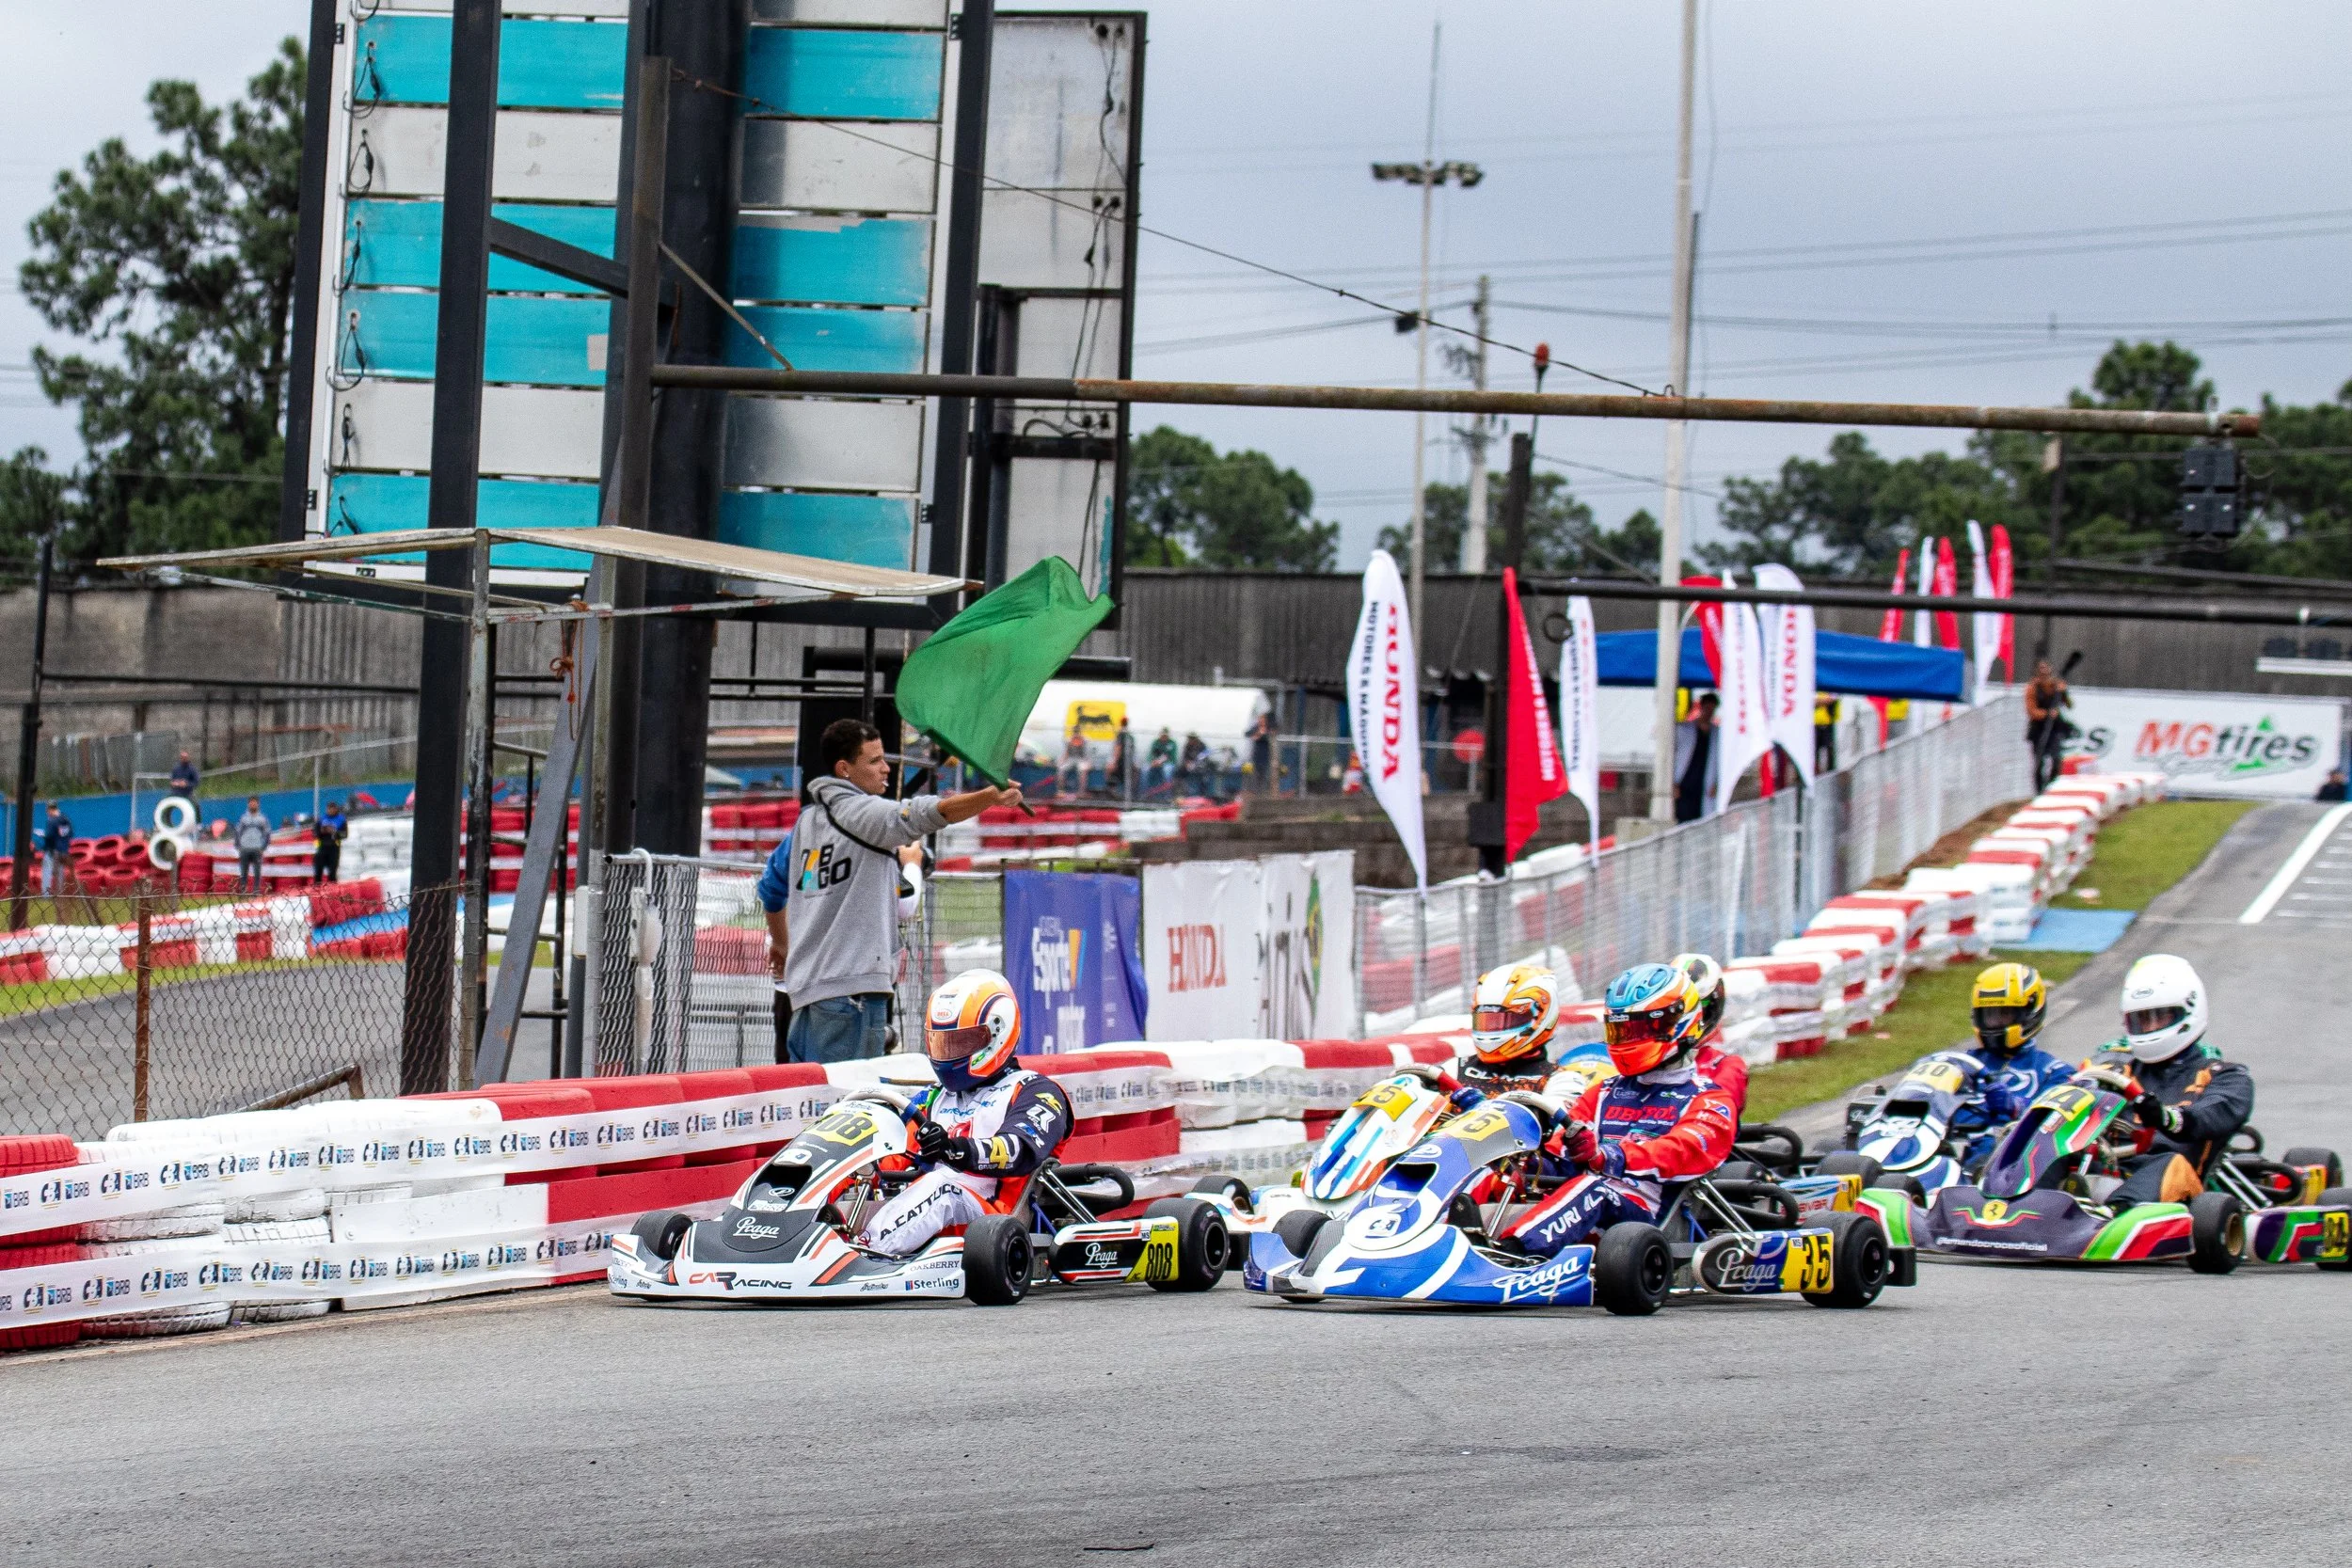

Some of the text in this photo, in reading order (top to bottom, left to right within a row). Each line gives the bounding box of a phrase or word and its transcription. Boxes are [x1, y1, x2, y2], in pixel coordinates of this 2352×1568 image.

[2134, 721, 2317, 764] MGtires
[1168, 924, 1226, 992] HNDA
[13, 1191, 29, 1207] BRB
[73, 1182, 89, 1197] BRB
[134, 1172, 150, 1188] BRB
[192, 1164, 209, 1179] BRB
[245, 1157, 260, 1172] BRB
[295, 1152, 310, 1166] BRB
[342, 1148, 355, 1163] BRB
[387, 1146, 400, 1160] BRB
[733, 1217, 780, 1240] Praga
[880, 1183, 962, 1241] A.CATTUCCI
[1539, 1207, 1582, 1243] YURI
[910, 1260, 960, 1272] OAKBERRY
[1085, 1243, 1118, 1268] Praga
[1145, 1243, 1173, 1281] 808
[1716, 1247, 1776, 1292] Praga
[1801, 1235, 1831, 1290] 35
[56, 1288, 72, 1304] BRB
[115, 1279, 131, 1295] BRB
[171, 1272, 188, 1288] BRB
[230, 1267, 243, 1282] BRB
[278, 1266, 294, 1280] BRB
[329, 1265, 342, 1279] BRB
[375, 1262, 389, 1277] BRB
[914, 1277, 960, 1290] Sterling
[1492, 1256, 1583, 1305] Praga
